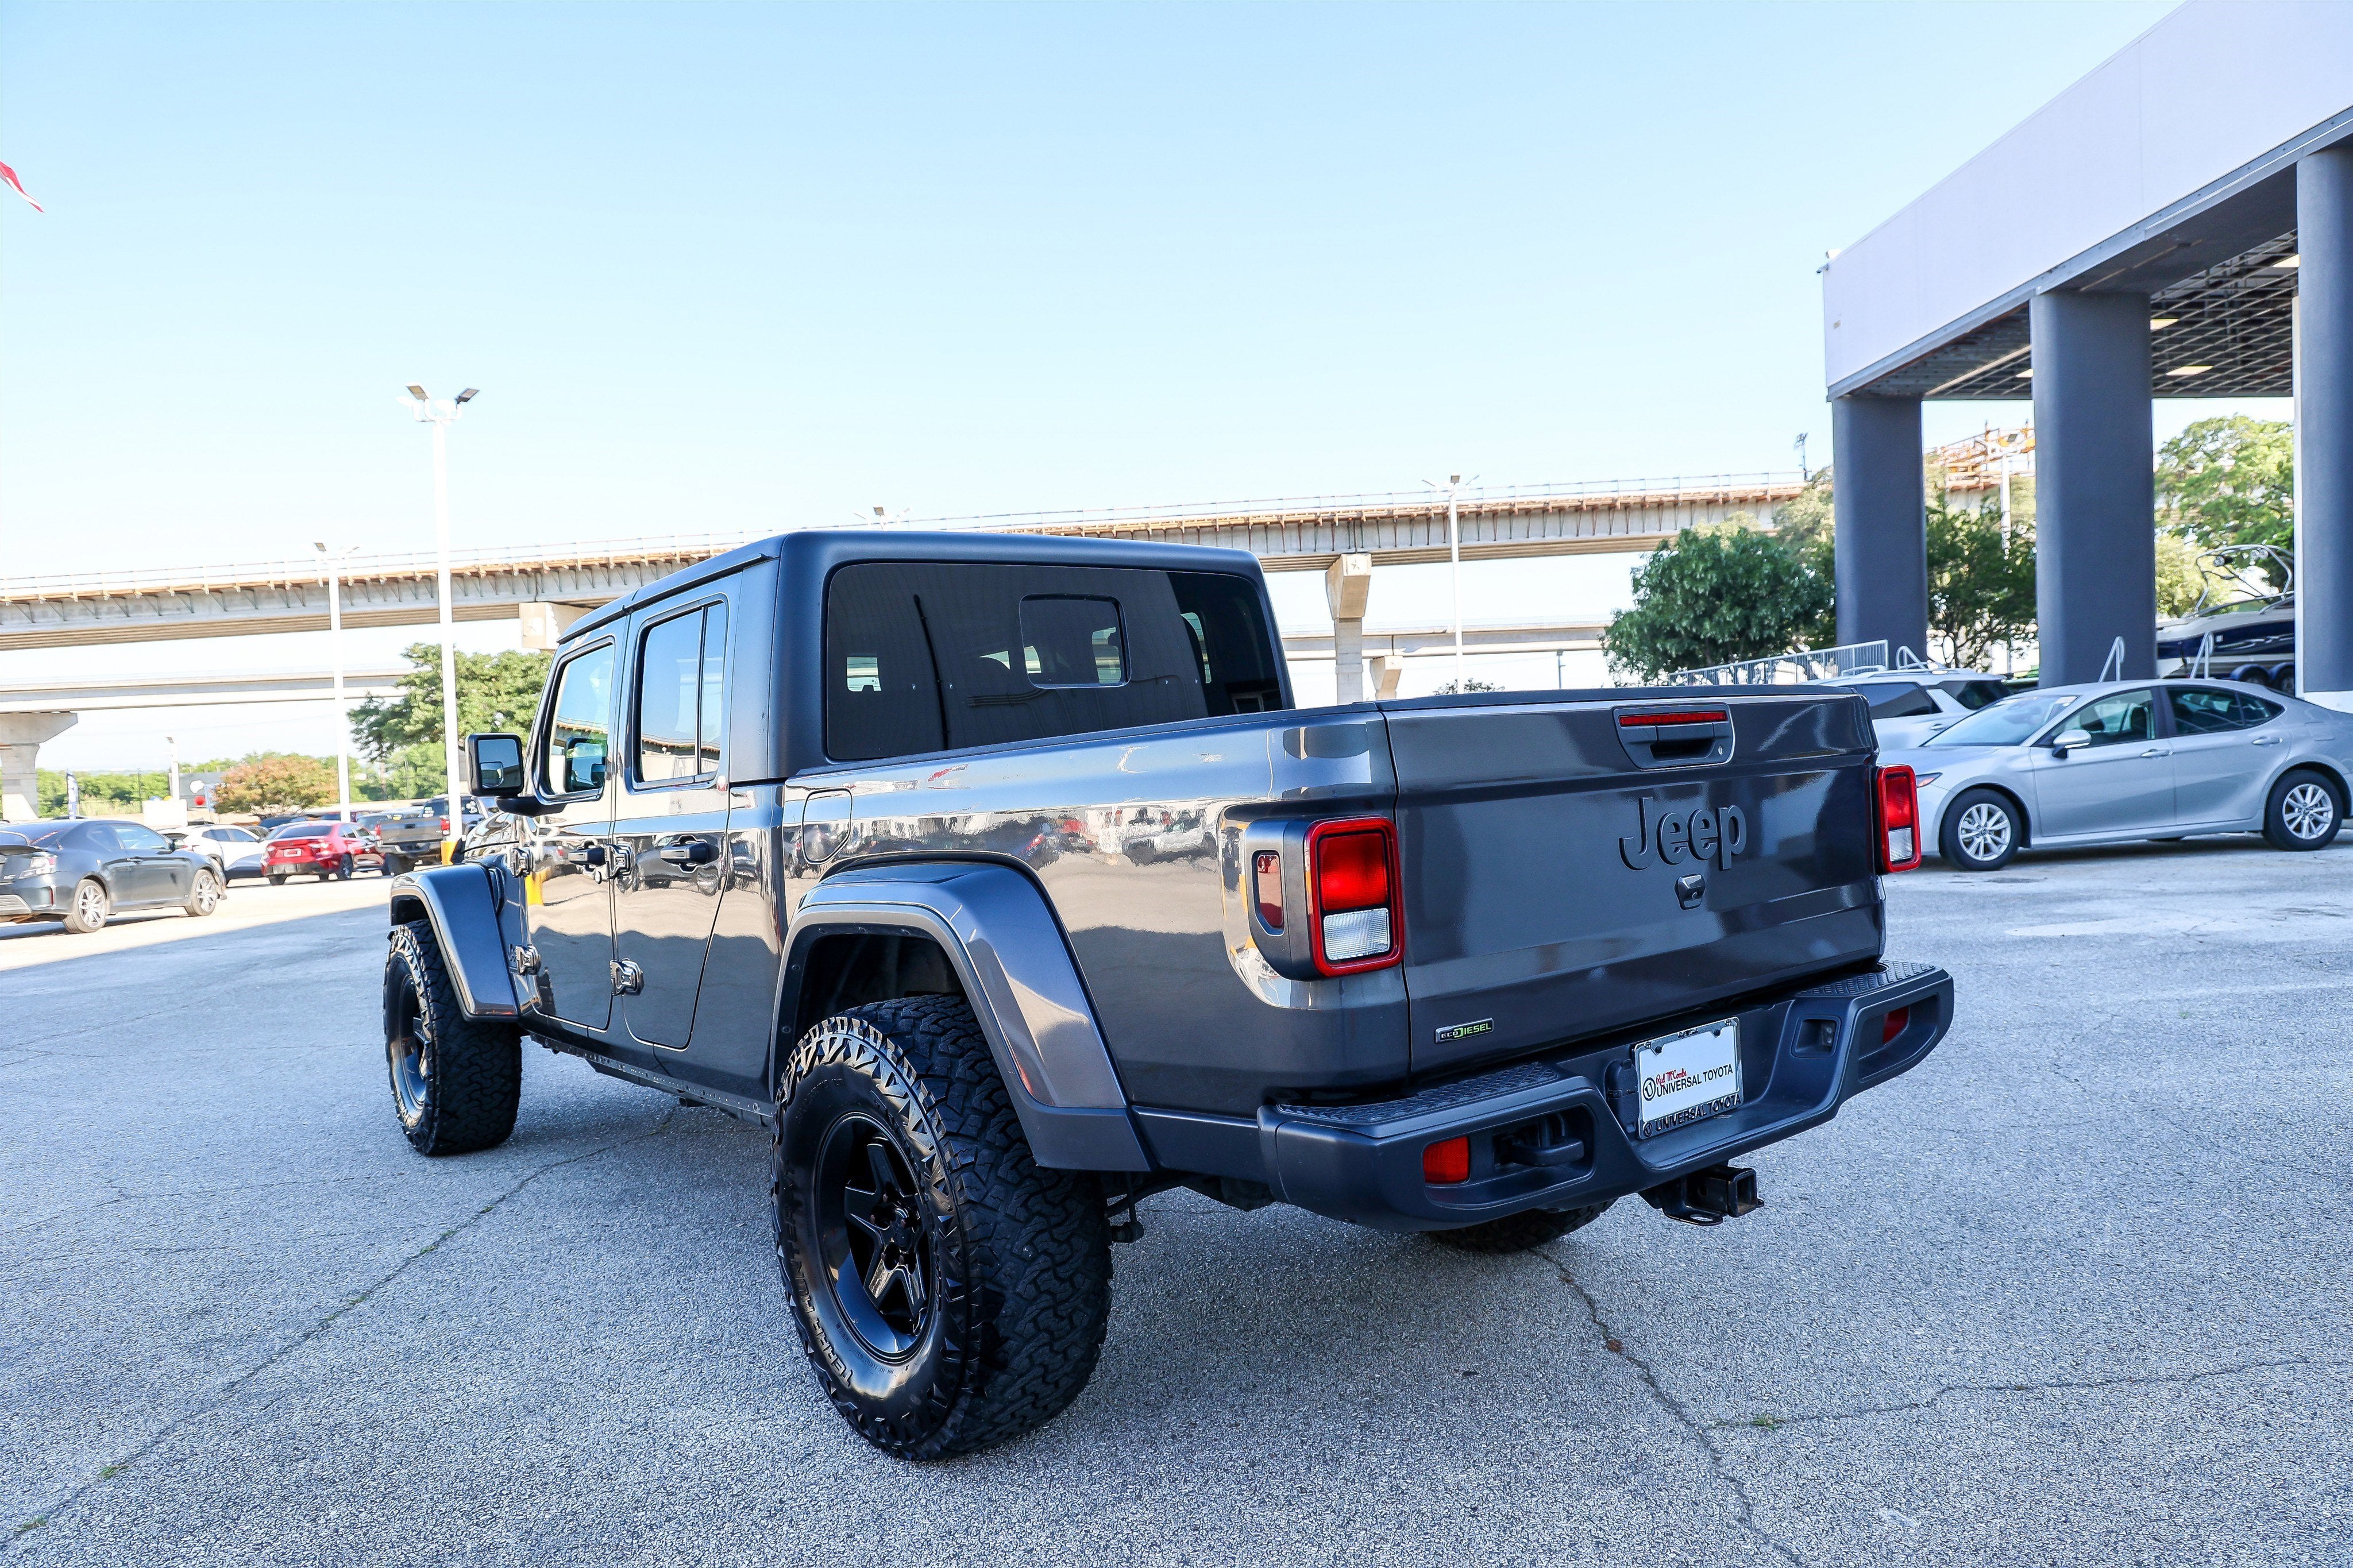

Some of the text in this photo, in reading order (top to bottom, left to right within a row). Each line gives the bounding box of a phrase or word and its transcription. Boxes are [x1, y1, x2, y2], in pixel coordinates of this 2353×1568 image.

[1619, 797, 1747, 871] Jeep
[1656, 1073, 1665, 1086] Red
[1657, 1064, 1733, 1097] UNIVERSAL TOYOTA
[1655, 1093, 1741, 1131] UNIVERSAL TOYOTA
[813, 1317, 853, 1387] TERRA
